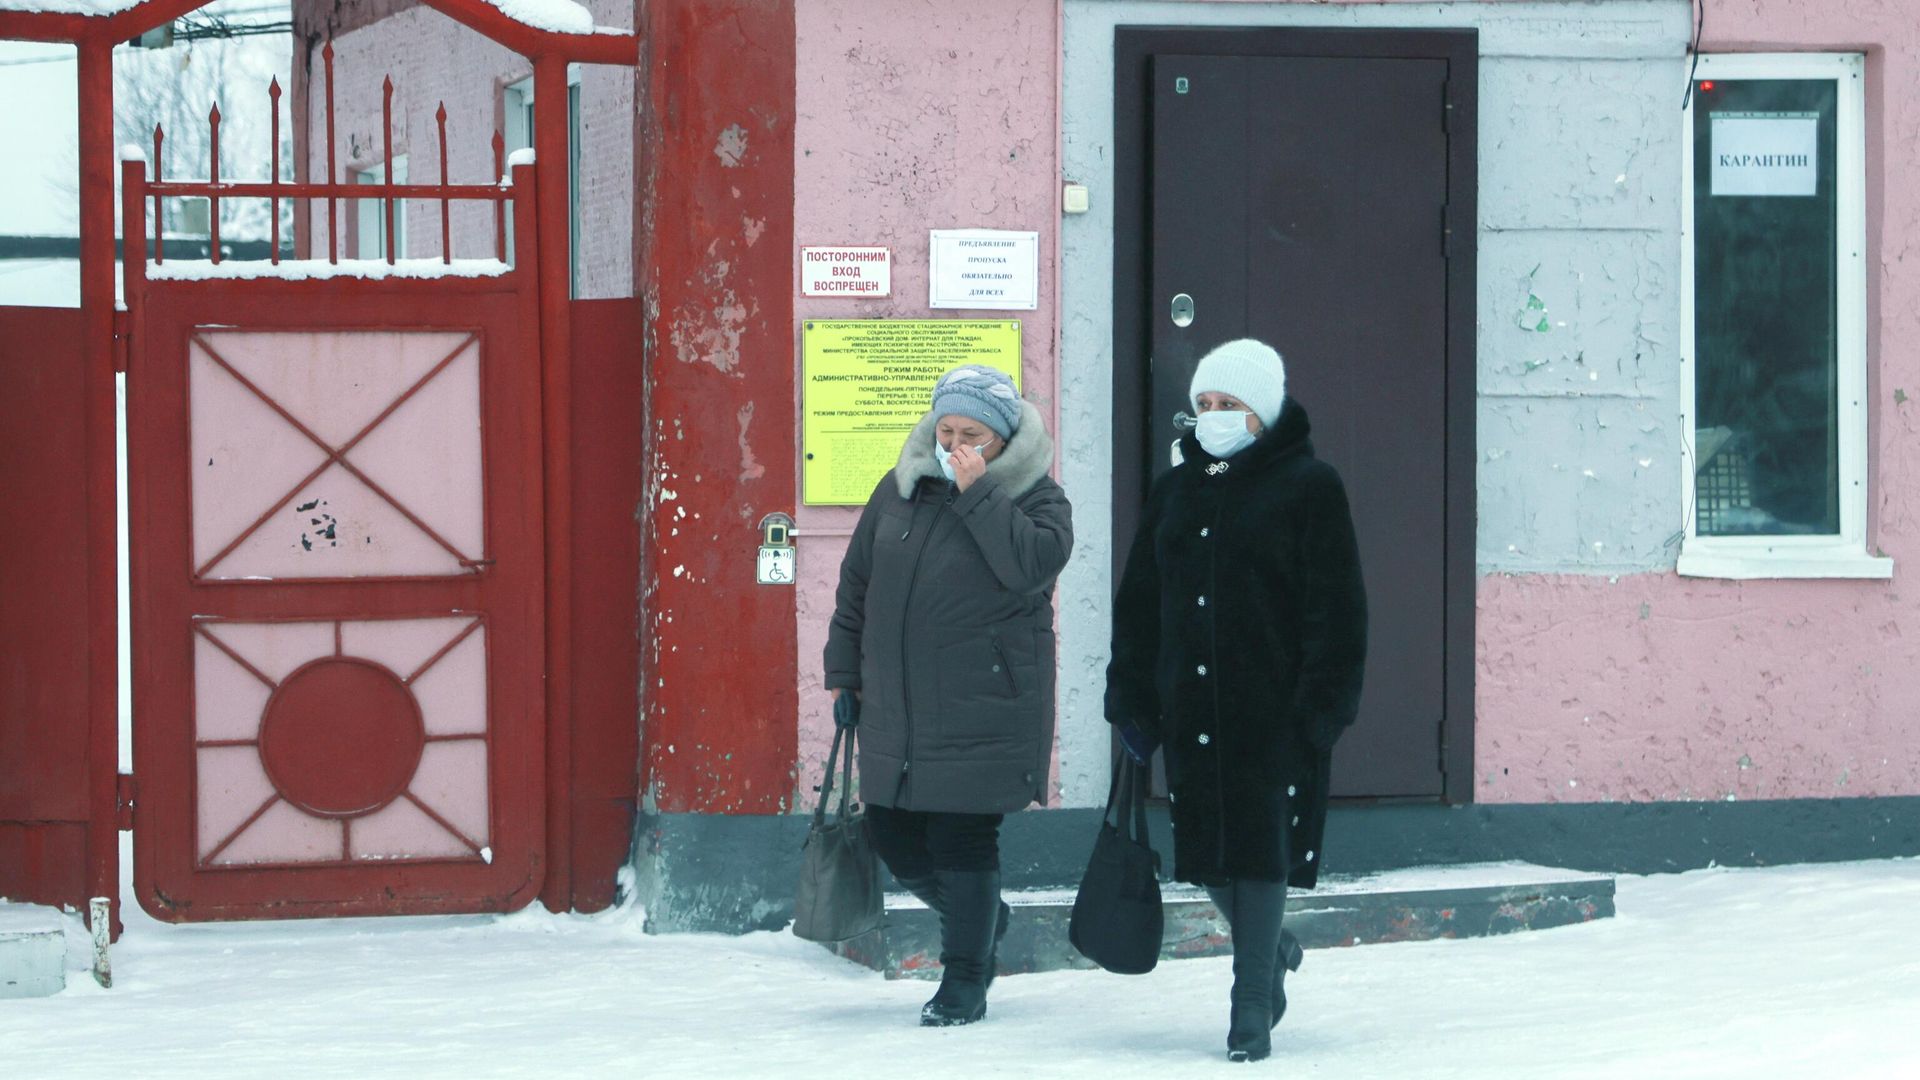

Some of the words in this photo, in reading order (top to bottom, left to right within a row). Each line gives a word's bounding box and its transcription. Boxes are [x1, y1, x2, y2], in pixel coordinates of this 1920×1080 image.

[1720, 154, 1808, 167] КАРАНТИН
[958, 240, 1016, 248] ПРЕДЪЯВЛЕНИЕ
[806, 252, 886, 262] ПОСТОРОННИМ
[832, 266, 861, 278] ВХОД
[814, 281, 879, 293] ВОСПРЕЩЕН
